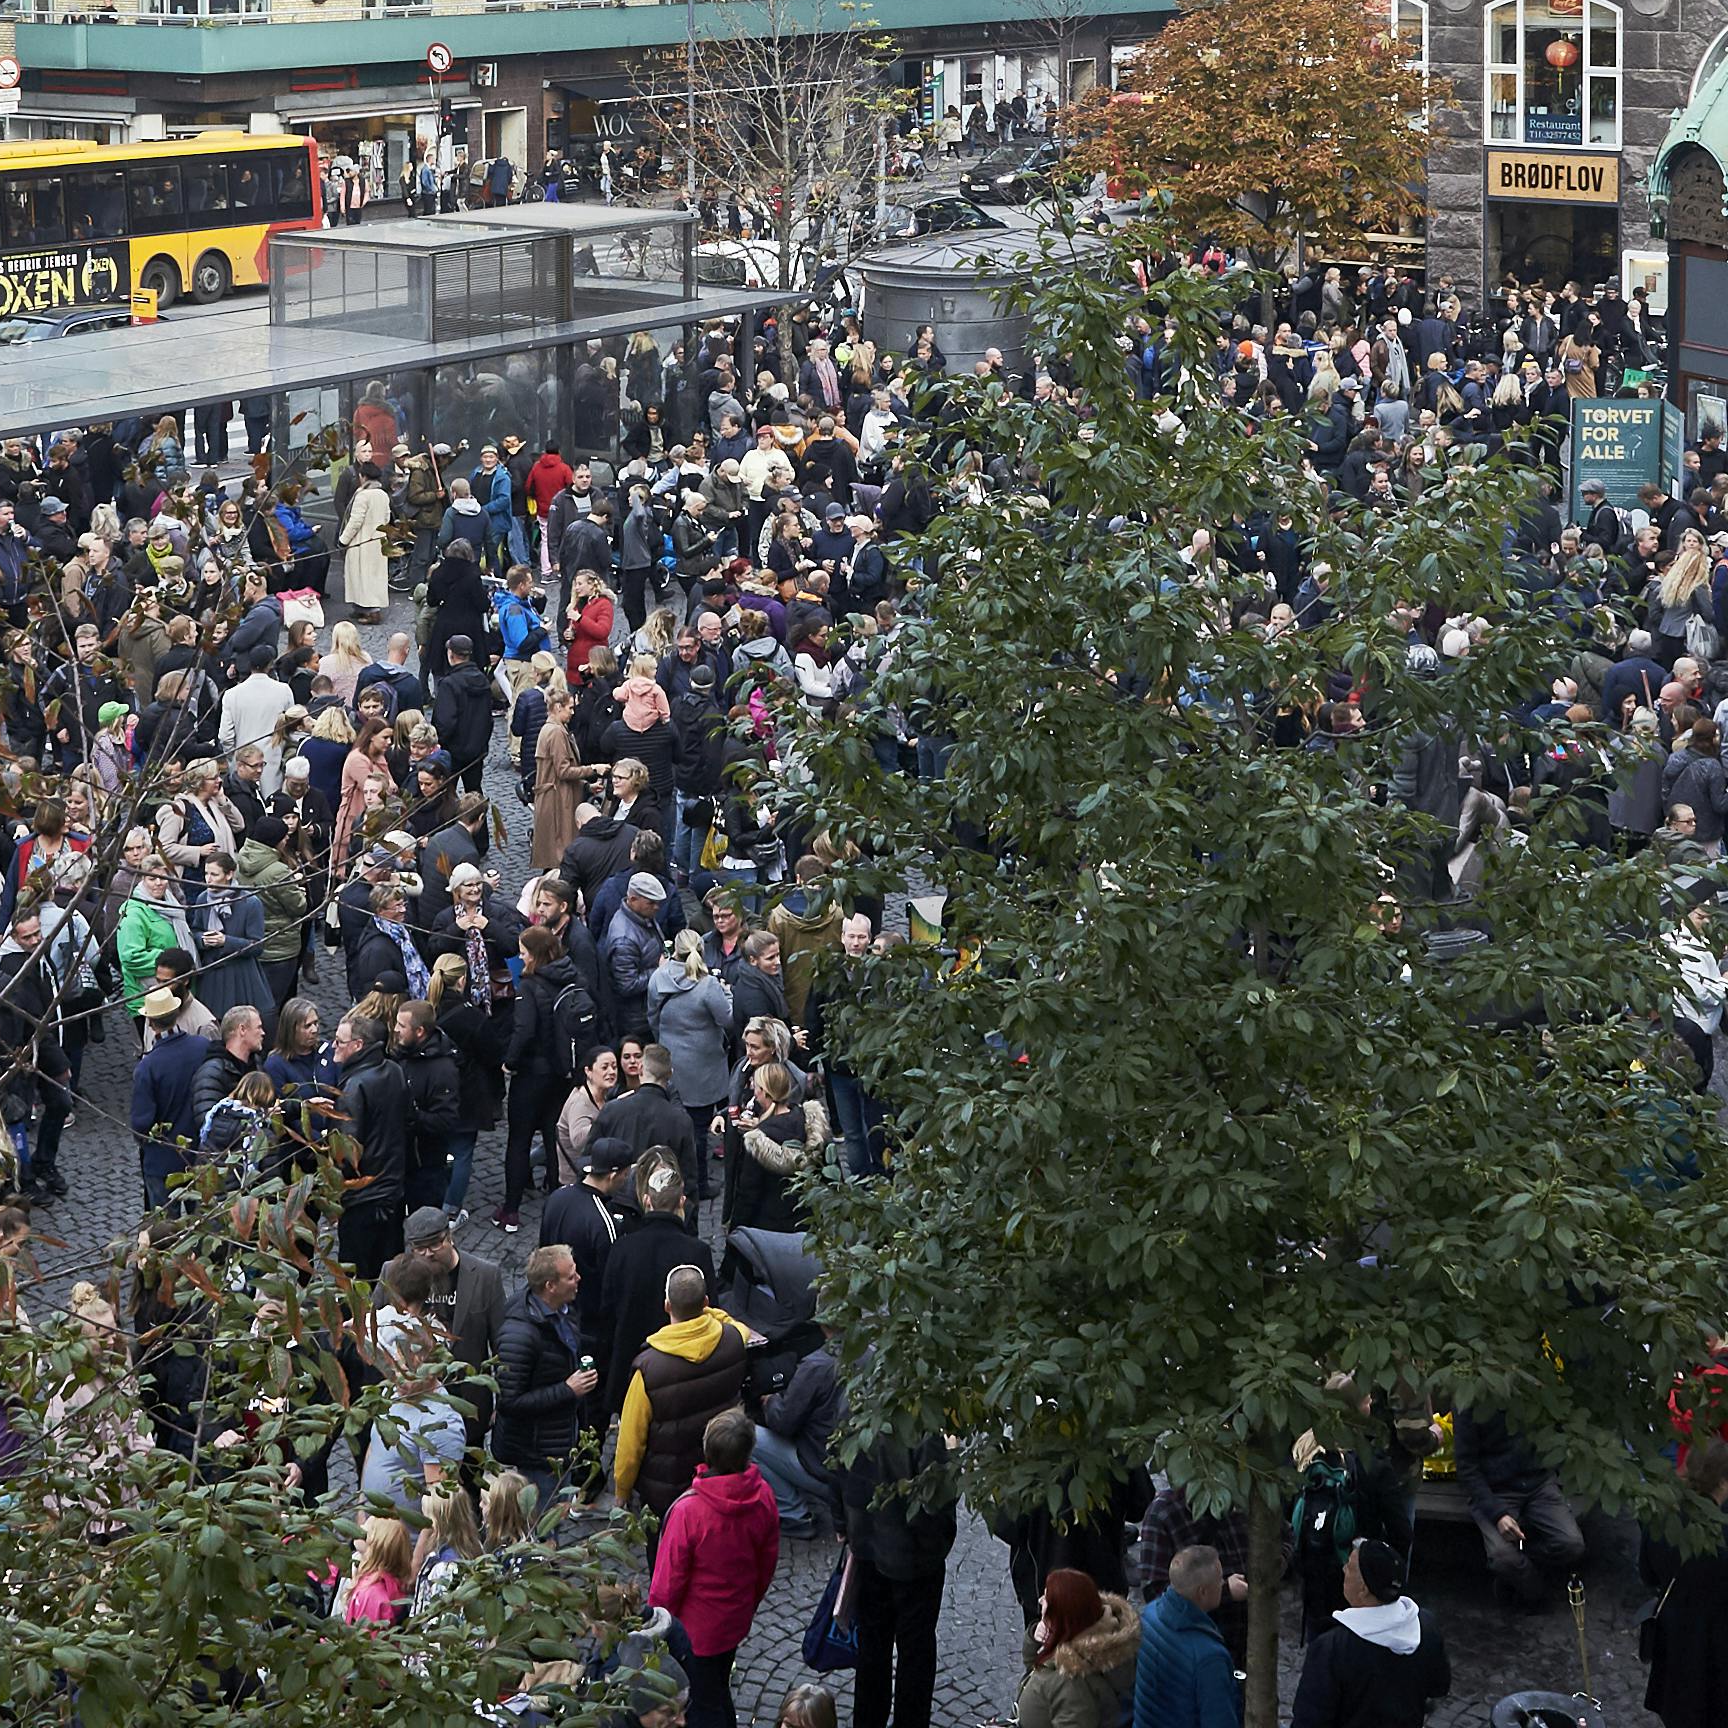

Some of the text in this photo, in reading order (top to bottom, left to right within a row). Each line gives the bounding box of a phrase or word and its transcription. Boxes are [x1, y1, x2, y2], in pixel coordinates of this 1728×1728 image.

[1529, 119, 1582, 130] Restaurant
[1500, 162, 1604, 193] BRØDFLOV
[7, 258, 42, 273] HENRIK
[45, 253, 78, 269] JENSEN
[1581, 408, 1655, 424] TORVET
[1582, 426, 1619, 442] FOR
[1580, 444, 1625, 460] ALLE
